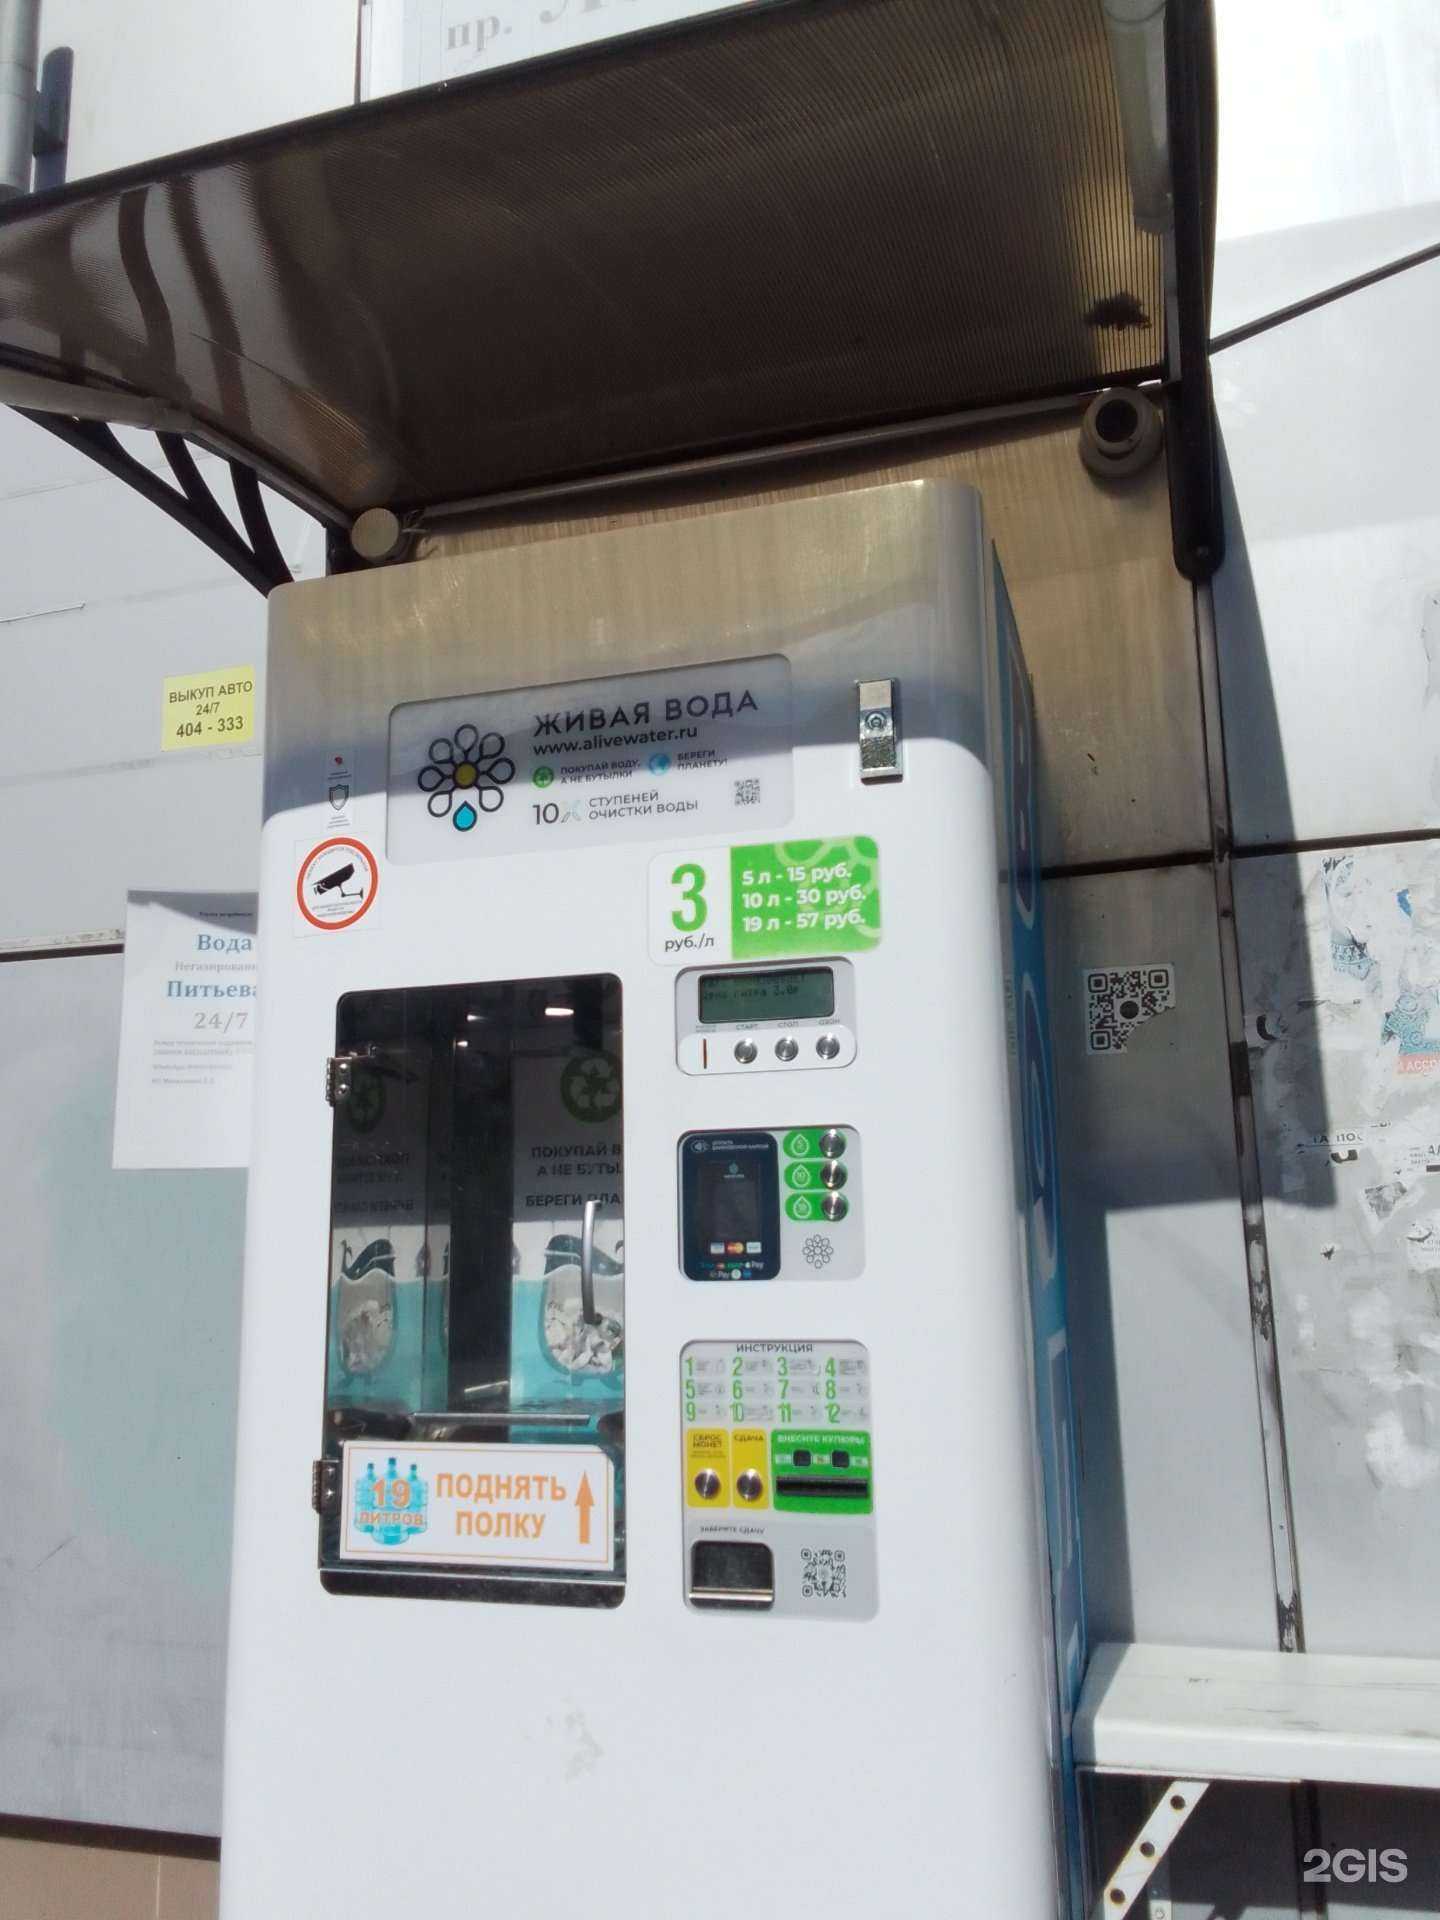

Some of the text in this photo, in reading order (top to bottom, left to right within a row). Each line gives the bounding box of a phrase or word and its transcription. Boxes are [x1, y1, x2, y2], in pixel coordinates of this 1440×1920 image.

[168, 680, 254, 704] ВЫКУП АВТО
[195, 701, 221, 716] 24/7
[533, 690, 759, 738] ЖИВАЯ ВОДА
[176, 721, 203, 738] 404
[217, 715, 244, 733] 333
[532, 726, 699, 756] www.alivewater.ru
[677, 749, 716, 761] БЕРЕГИ
[560, 760, 609, 775] ПОКУПАЙ
[560, 776, 567, 785] А
[532, 789, 659, 826] 10 СТУПЕНЕЙ
[588, 799, 698, 821] ОЧИСТКИ ВОДЫ
[742, 870, 753, 886] 5
[758, 871, 771, 884] л
[786, 866, 805, 882] 15
[811, 863, 852, 881] руб.
[670, 863, 708, 933] 3
[742, 892, 762, 909] 10
[766, 894, 780, 907] л
[796, 889, 820, 905] 30
[825, 884, 866, 906] руб.
[742, 916, 762, 933] 19
[766, 917, 780, 931] л
[796, 913, 818, 928] 57
[824, 909, 865, 928] руб.
[197, 934, 252, 955] Вода
[665, 932, 715, 952] руб./л
[193, 1011, 249, 1033] 24/7
[531, 1142, 607, 1159] ПОКУПАЙ
[536, 1161, 621, 1177] А НЕ БУТЫ
[525, 1194, 582, 1208] БЕРЕГИ
[736, 1343, 813, 1353] ИНСТРУКЦИЯ
[685, 1357, 693, 1376] 1
[732, 1356, 743, 1377] 2
[777, 1356, 788, 1377] 3
[825, 1356, 836, 1377] 4
[685, 1379, 695, 1399] 5
[732, 1379, 743, 1399] 6
[778, 1379, 789, 1399] 7
[825, 1379, 836, 1399] 8
[686, 1402, 696, 1422] 9
[729, 1402, 744, 1422] 10
[777, 1402, 792, 1423] 11
[825, 1403, 840, 1423] 12
[777, 1434, 865, 1445] ВНЕСИТЕ КУПЮРЫ
[371, 1478, 411, 1507] 19
[435, 1472, 567, 1504] ПОДНЯТЬ
[357, 1511, 424, 1526] ЛИТРОВ
[455, 1510, 546, 1539] ПОЛКУ
